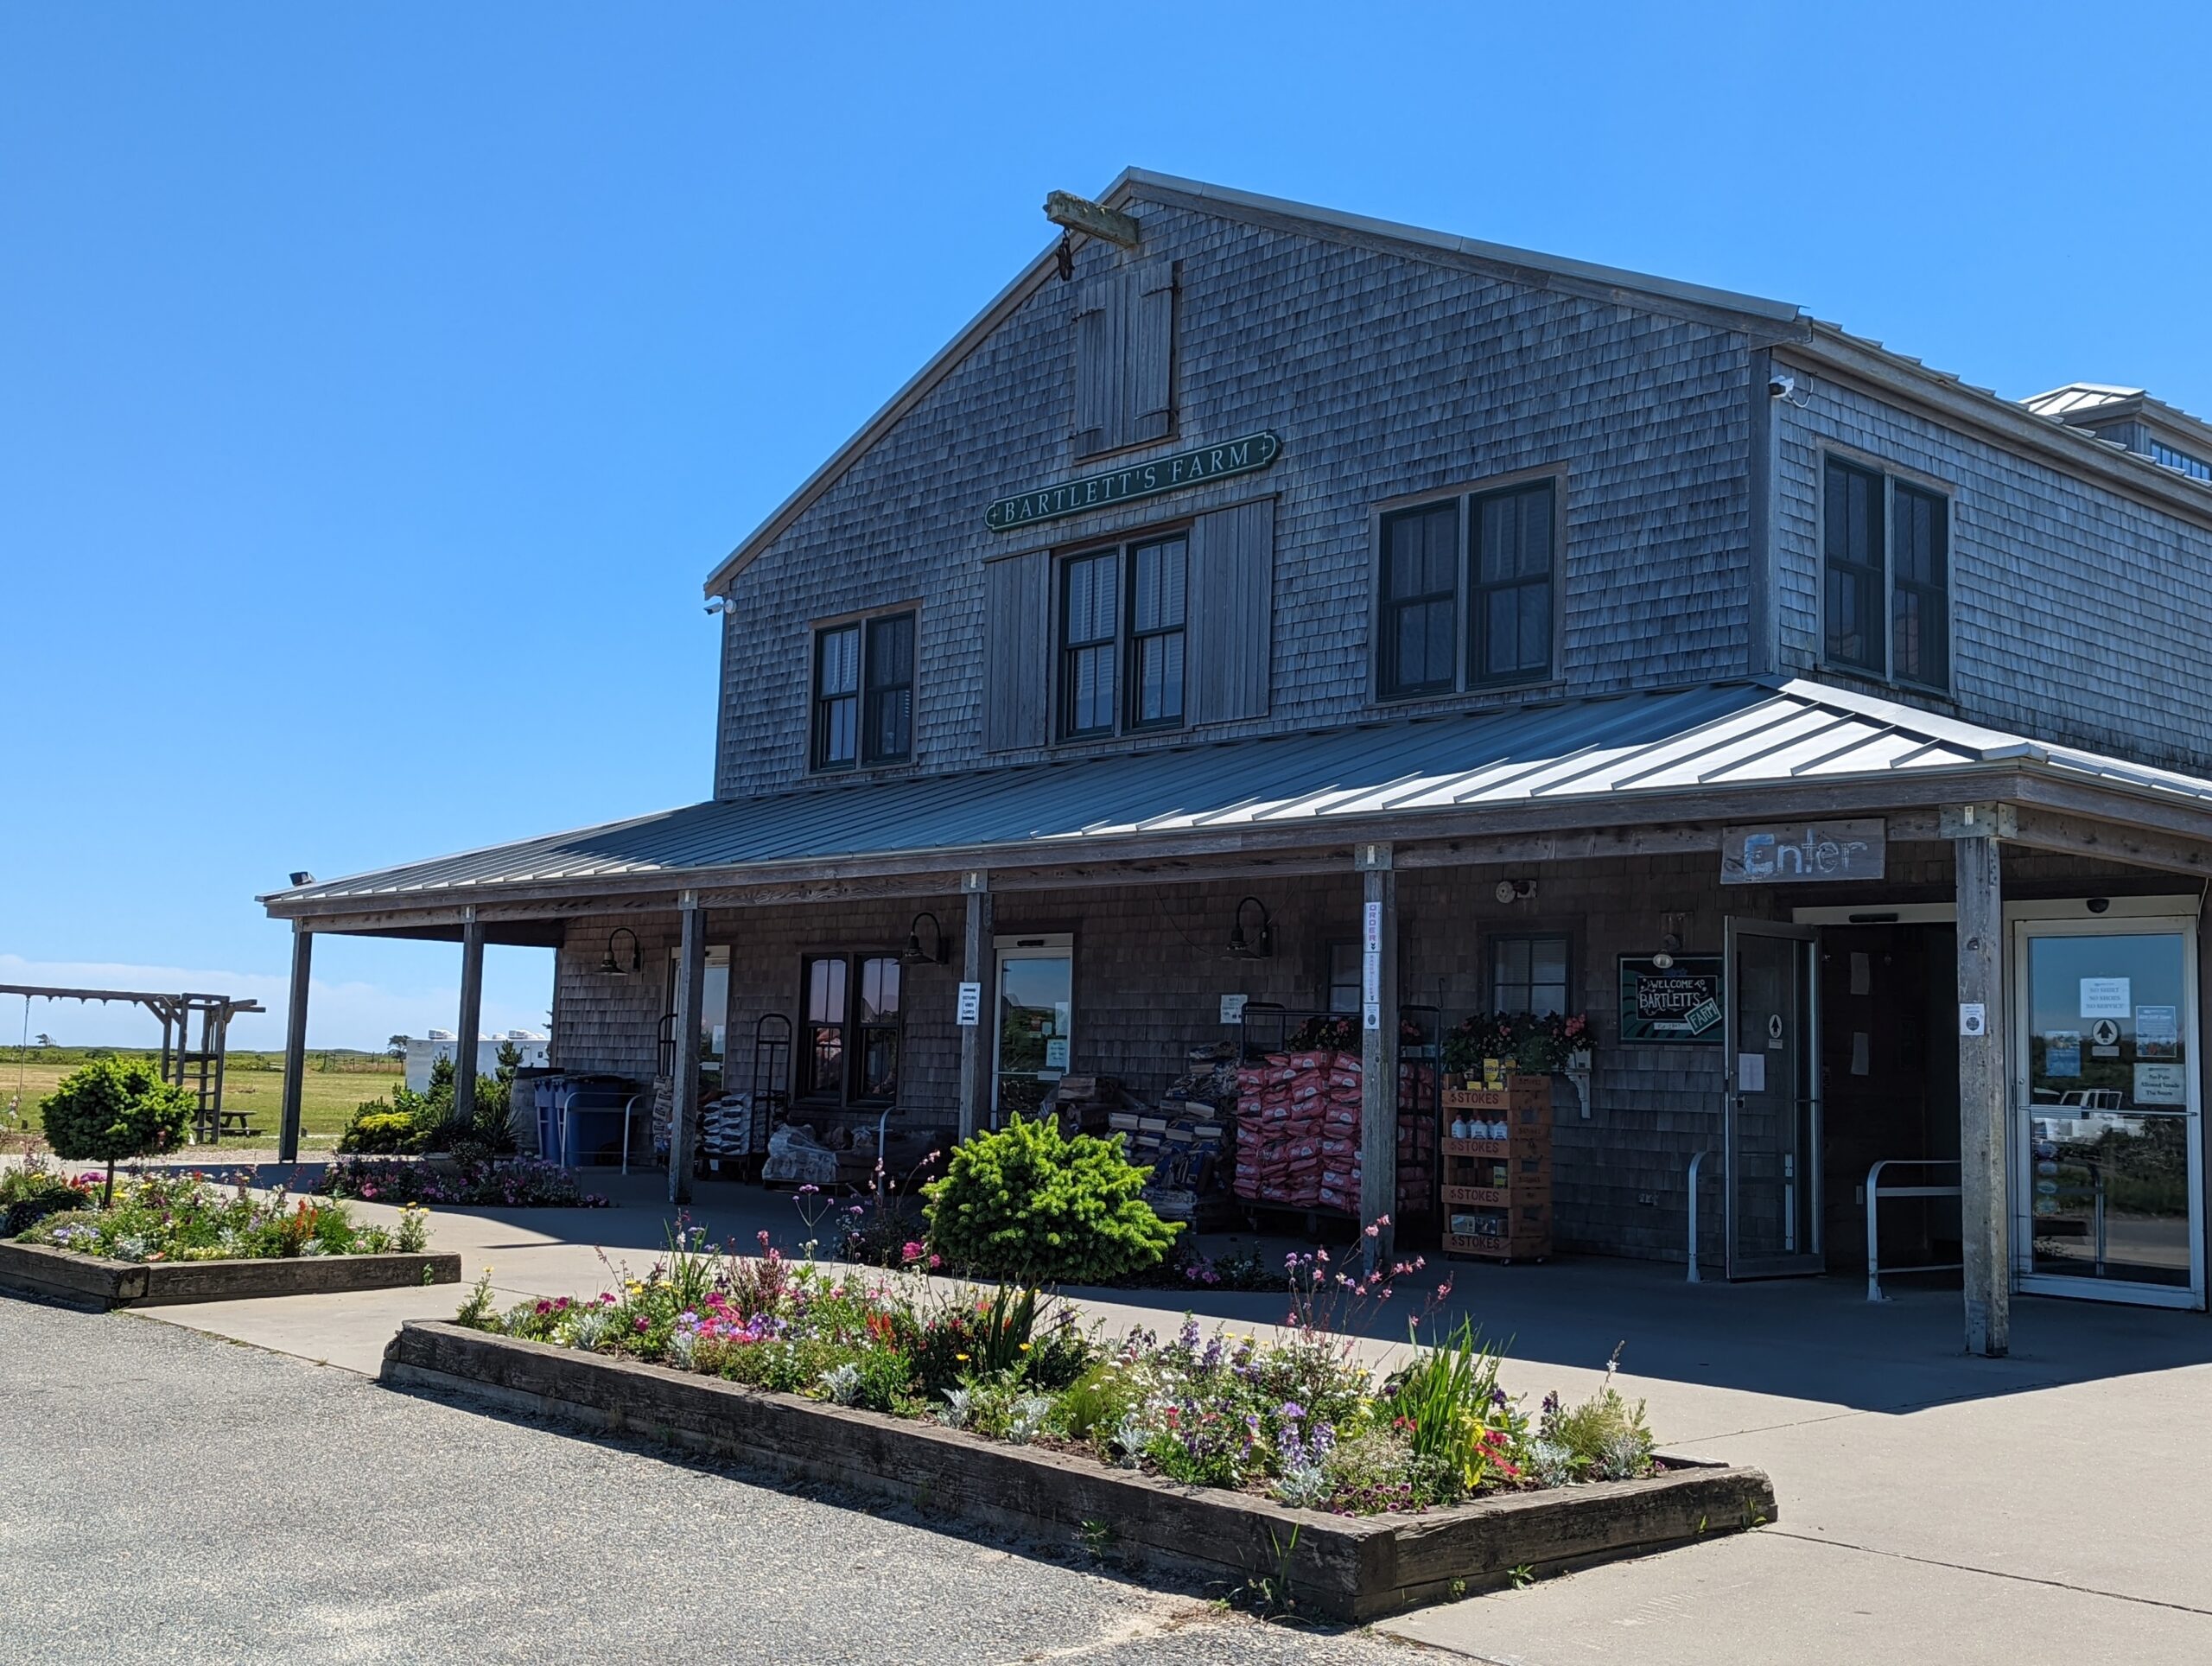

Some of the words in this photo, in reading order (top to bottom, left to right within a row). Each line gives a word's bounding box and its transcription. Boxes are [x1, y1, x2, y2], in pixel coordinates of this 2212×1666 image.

[1005, 467, 1156, 522] BARTLETT'S
[1173, 442, 1249, 482] FARM
[1744, 829, 1868, 875] Enter
[1649, 979, 1694, 989] WELCOME
[1690, 1002, 1718, 1029] FARM
